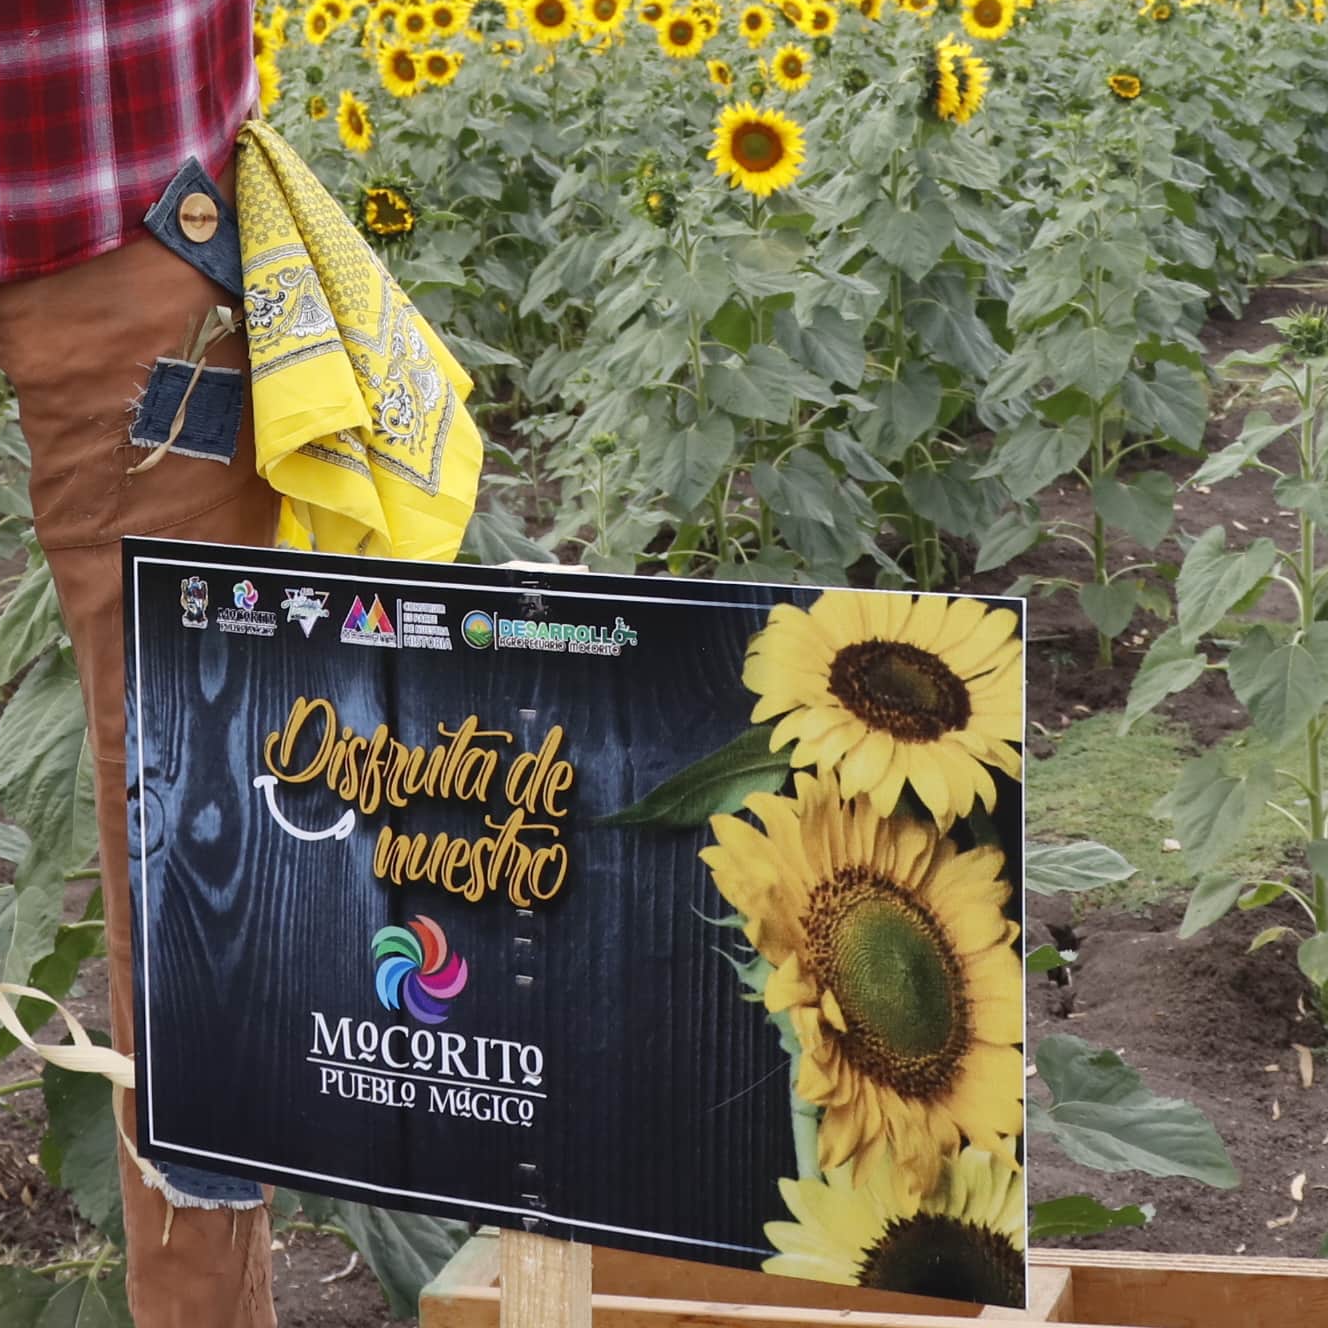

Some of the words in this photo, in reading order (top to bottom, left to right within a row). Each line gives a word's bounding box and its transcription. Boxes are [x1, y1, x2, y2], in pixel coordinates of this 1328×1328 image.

[498, 618, 627, 646] DESARROLLO
[263, 695, 513, 815] Disfruta
[504, 724, 574, 818] de
[373, 807, 569, 907] nuestro
[308, 1011, 545, 1087] MOCORITO
[319, 1066, 416, 1109] PUEBLO
